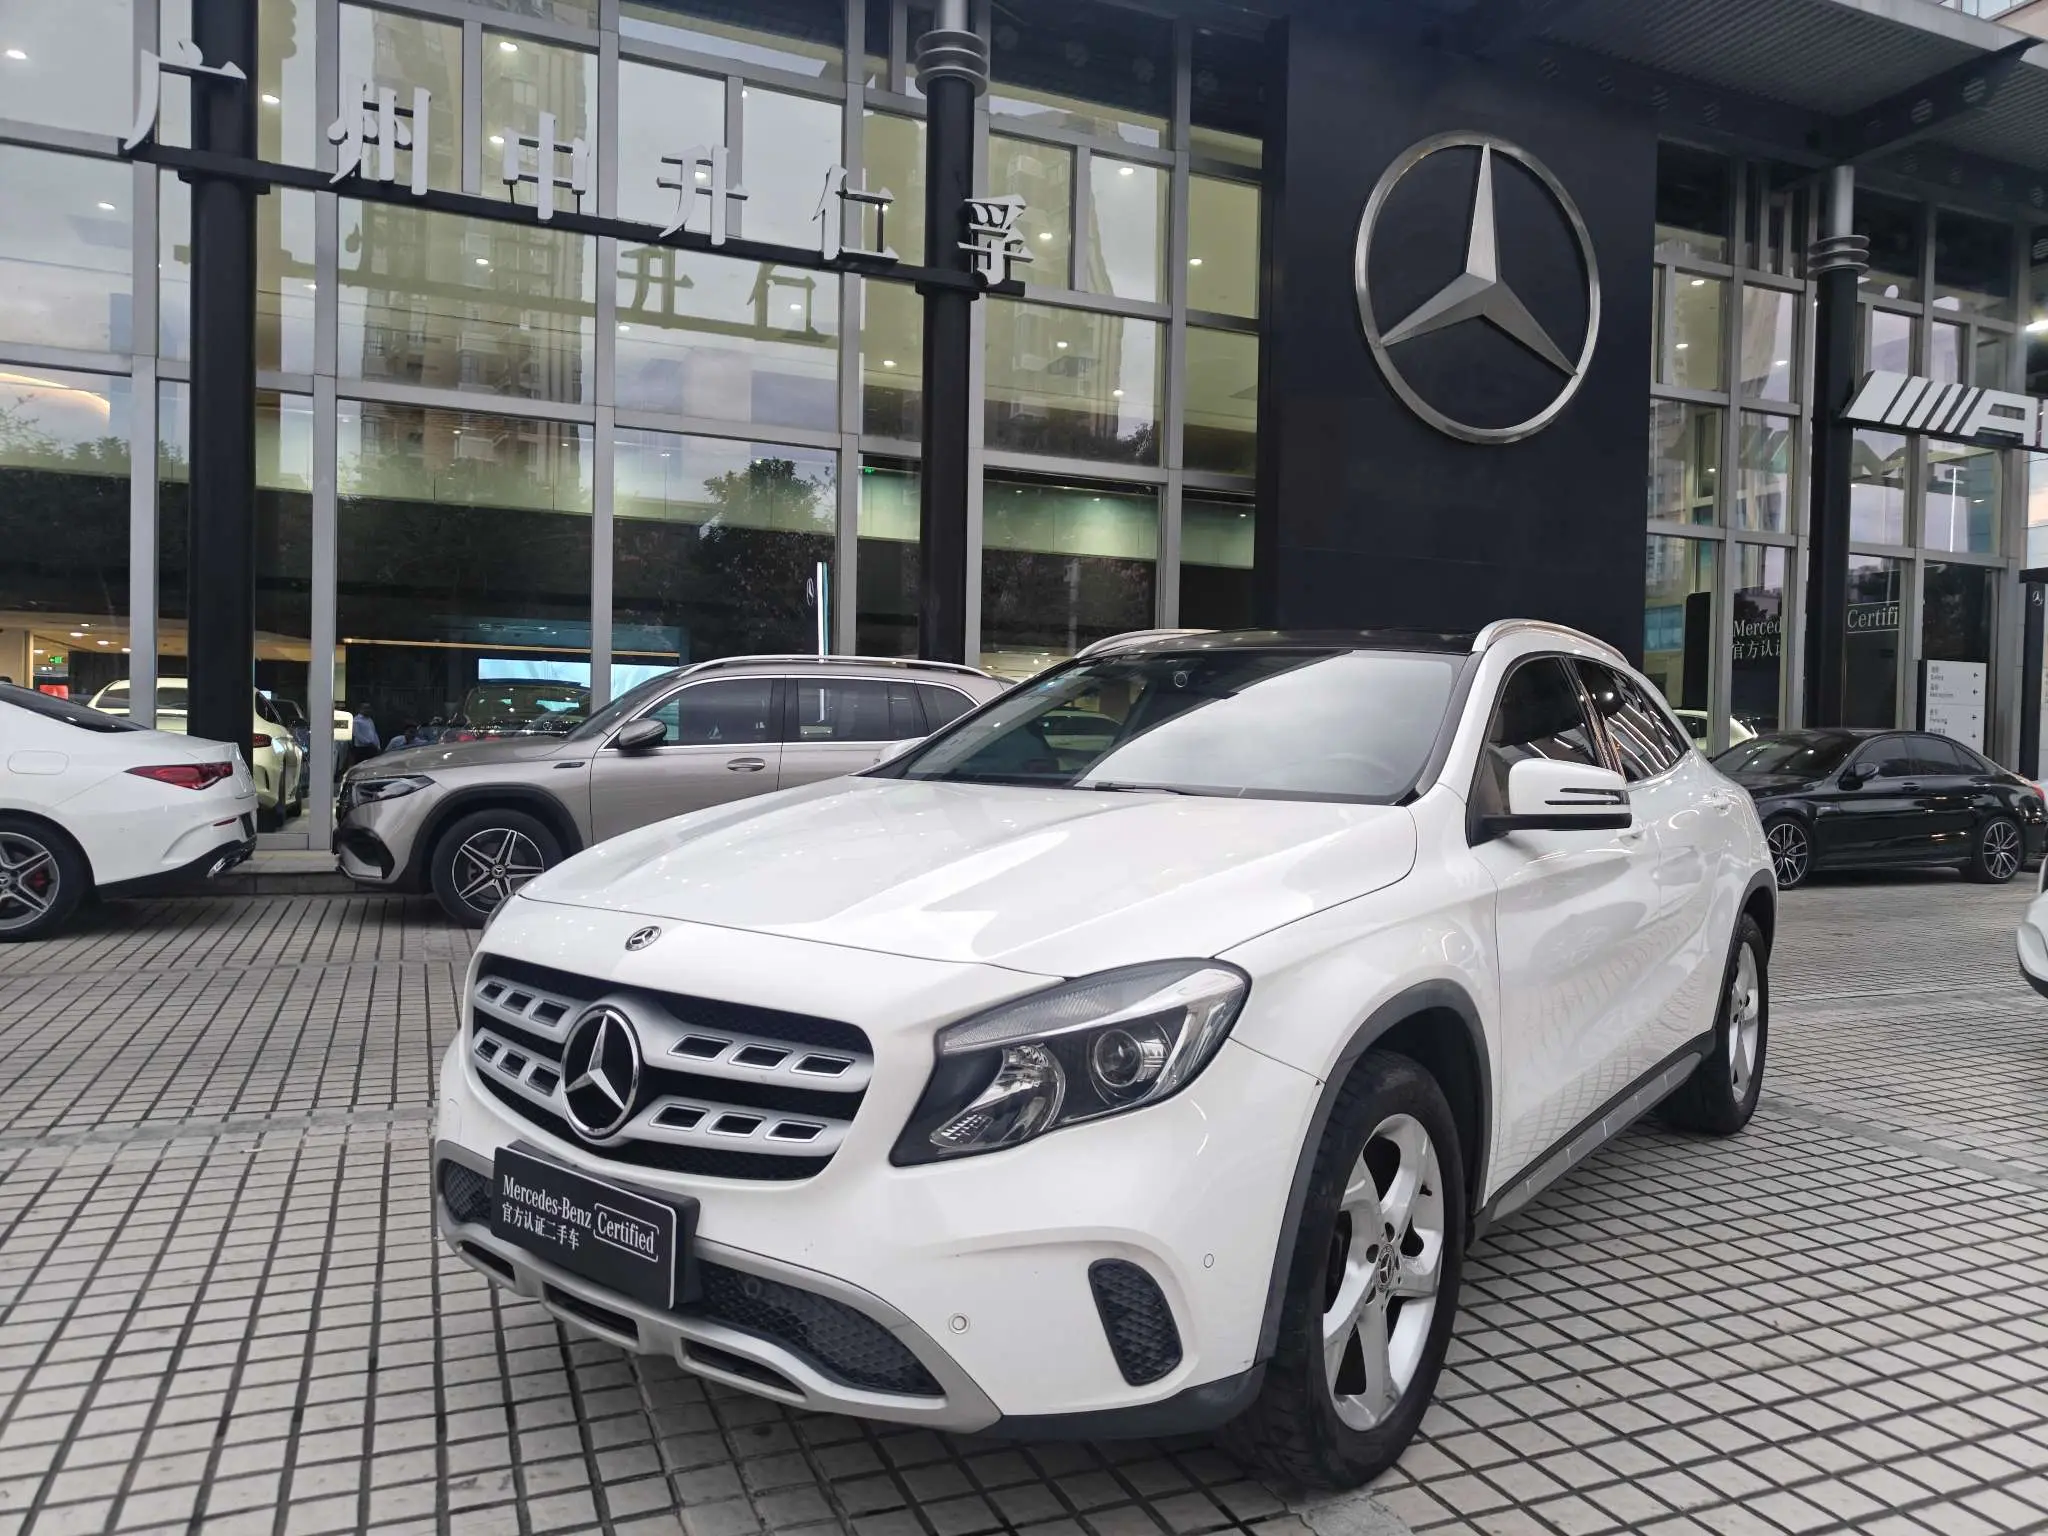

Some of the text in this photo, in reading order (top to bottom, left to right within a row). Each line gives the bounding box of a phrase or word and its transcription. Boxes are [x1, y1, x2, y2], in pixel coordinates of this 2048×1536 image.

[122, 39, 1034, 285] 广州中升仁孚
[502, 1174, 655, 1255] Mercedes-Benz Certified
[502, 1201, 580, 1251] 官方认证二手车
